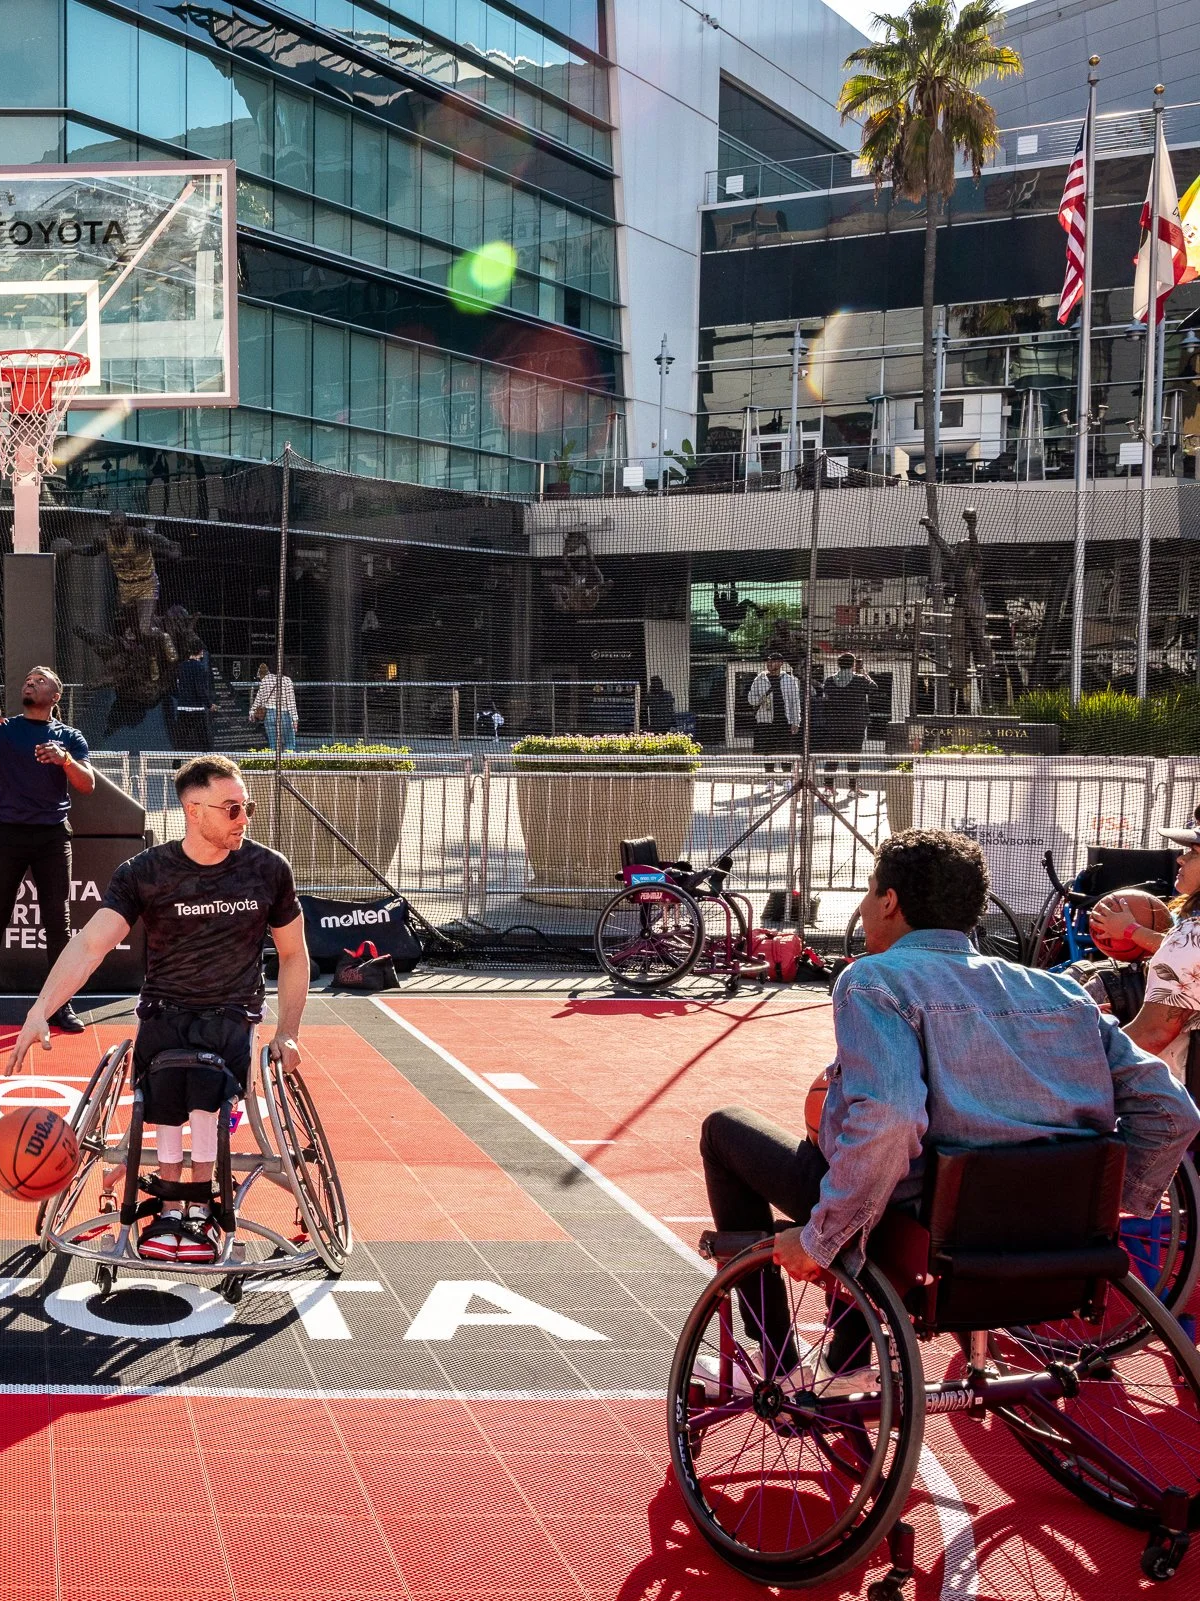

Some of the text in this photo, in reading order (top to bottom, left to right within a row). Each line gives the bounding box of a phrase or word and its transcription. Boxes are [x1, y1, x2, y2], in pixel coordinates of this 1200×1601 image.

[997, 729, 1029, 738] HOYA
[979, 830, 996, 838] SKI
[979, 837, 1045, 846] SNOWBOARD
[174, 898, 259, 917] TeamToyota
[321, 908, 391, 929] molten
[25, 1110, 58, 1157] Wilson
